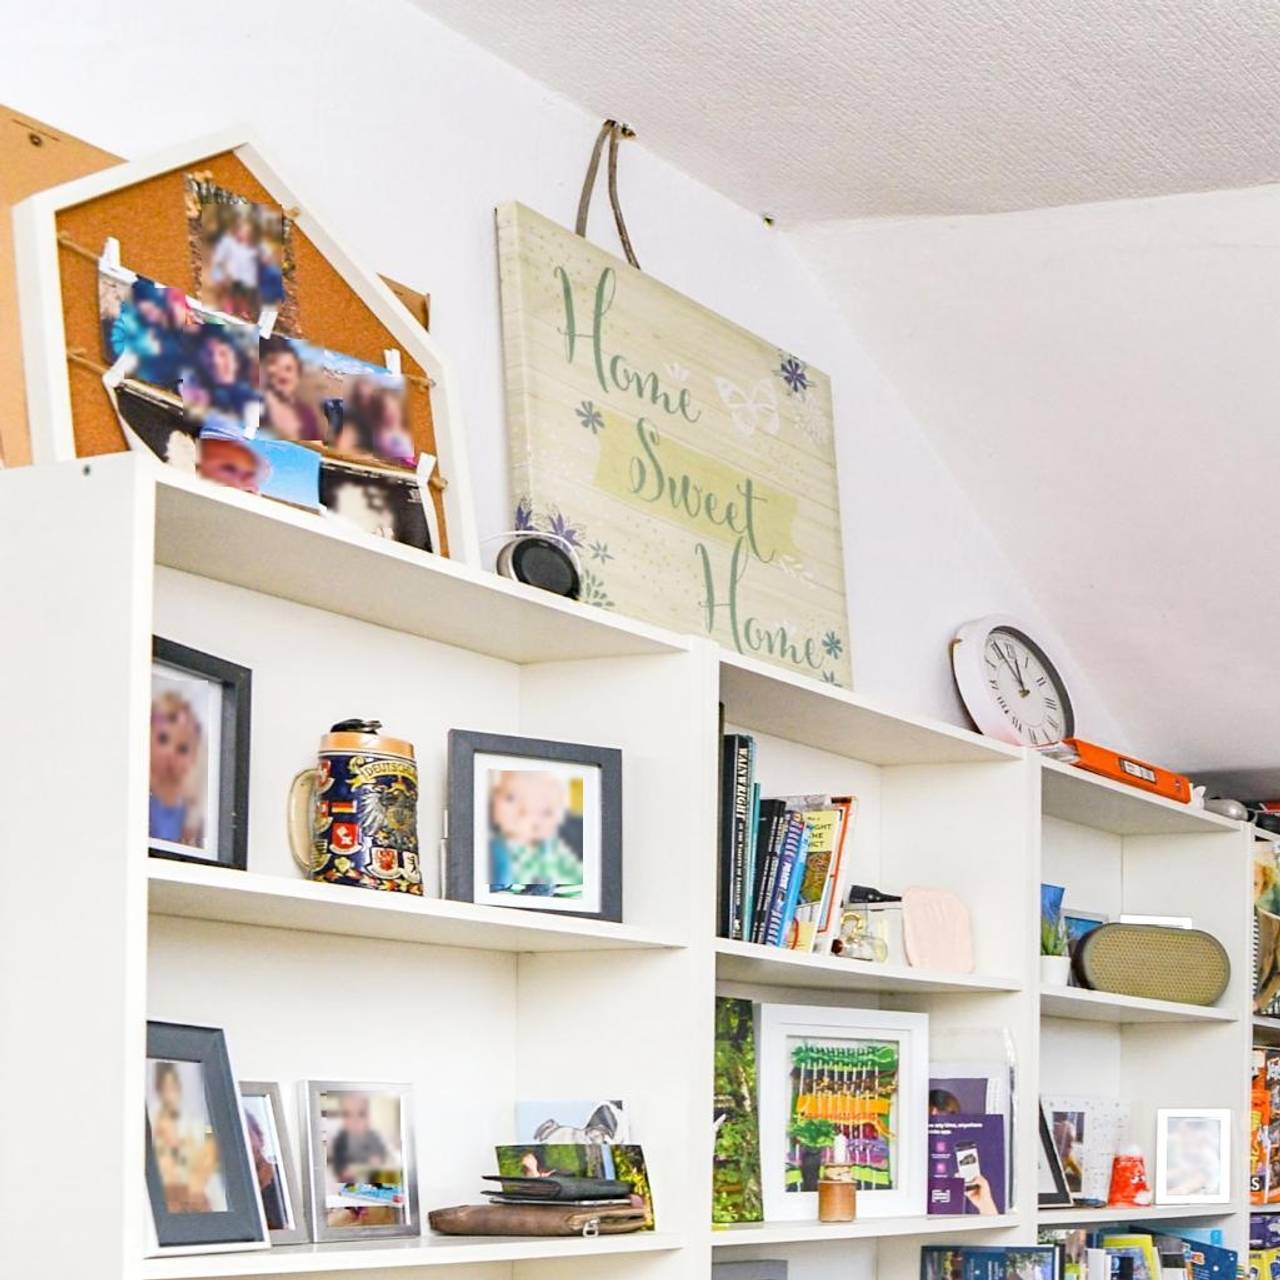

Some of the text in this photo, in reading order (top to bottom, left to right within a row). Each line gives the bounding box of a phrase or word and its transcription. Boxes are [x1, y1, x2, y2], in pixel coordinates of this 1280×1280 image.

[554, 266, 701, 423] Home
[629, 417, 774, 562] Sweet
[695, 536, 827, 671] Home
[736, 747, 749, 820] WAINWRIGHT
